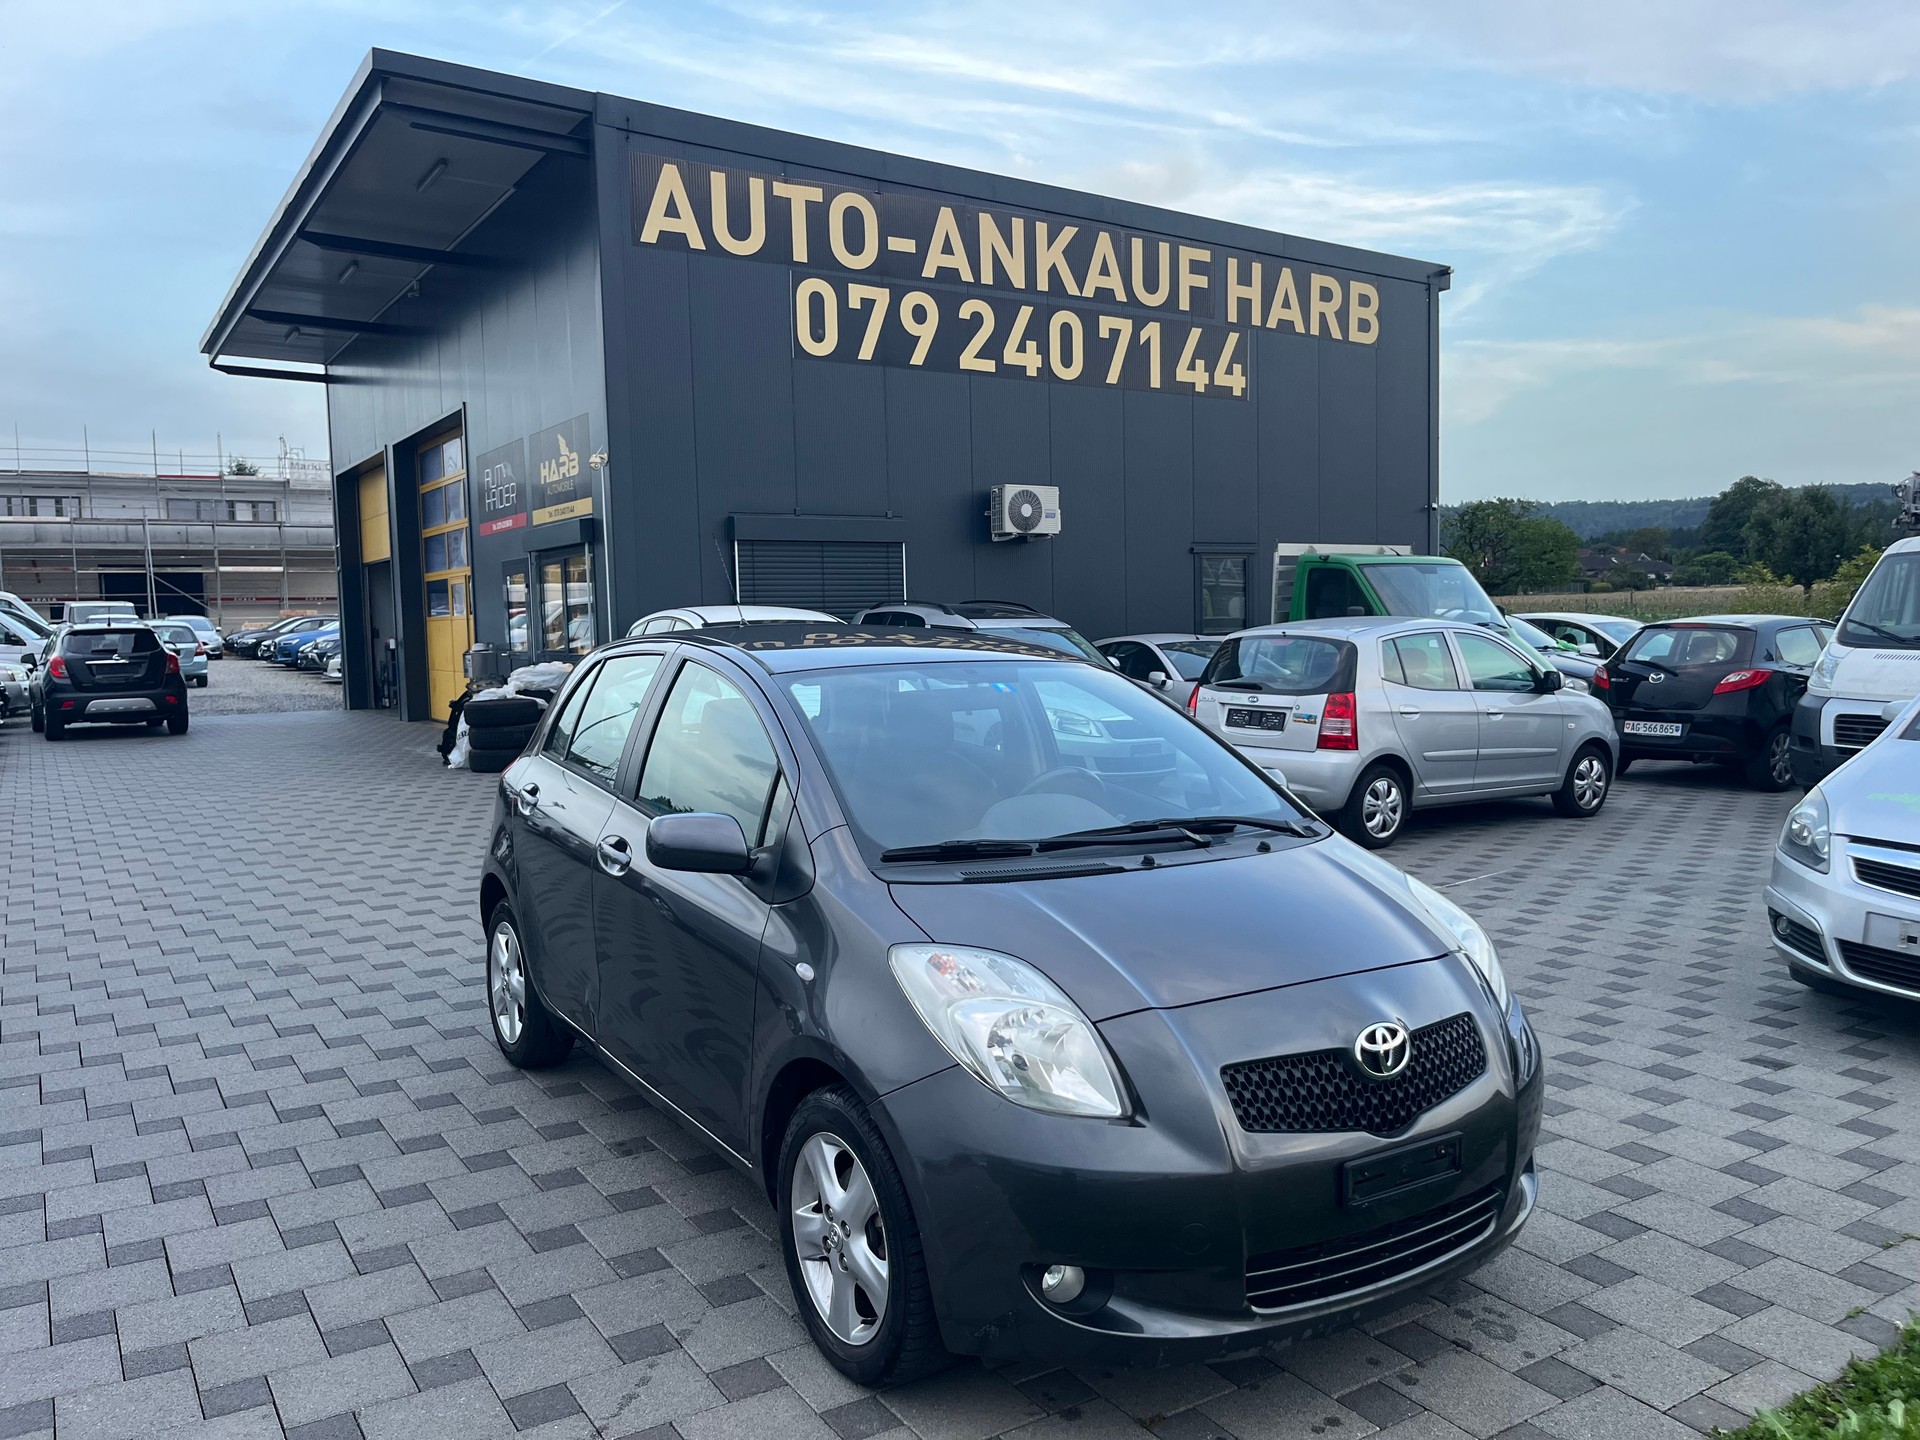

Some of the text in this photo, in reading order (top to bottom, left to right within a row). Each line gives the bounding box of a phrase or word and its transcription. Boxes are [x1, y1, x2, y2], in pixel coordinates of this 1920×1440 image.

[641, 163, 1381, 345] AUTO-ANKAUF HARB
[796, 278, 940, 366] 079
[959, 299, 1084, 381] 240
[540, 452, 579, 485] HARB
